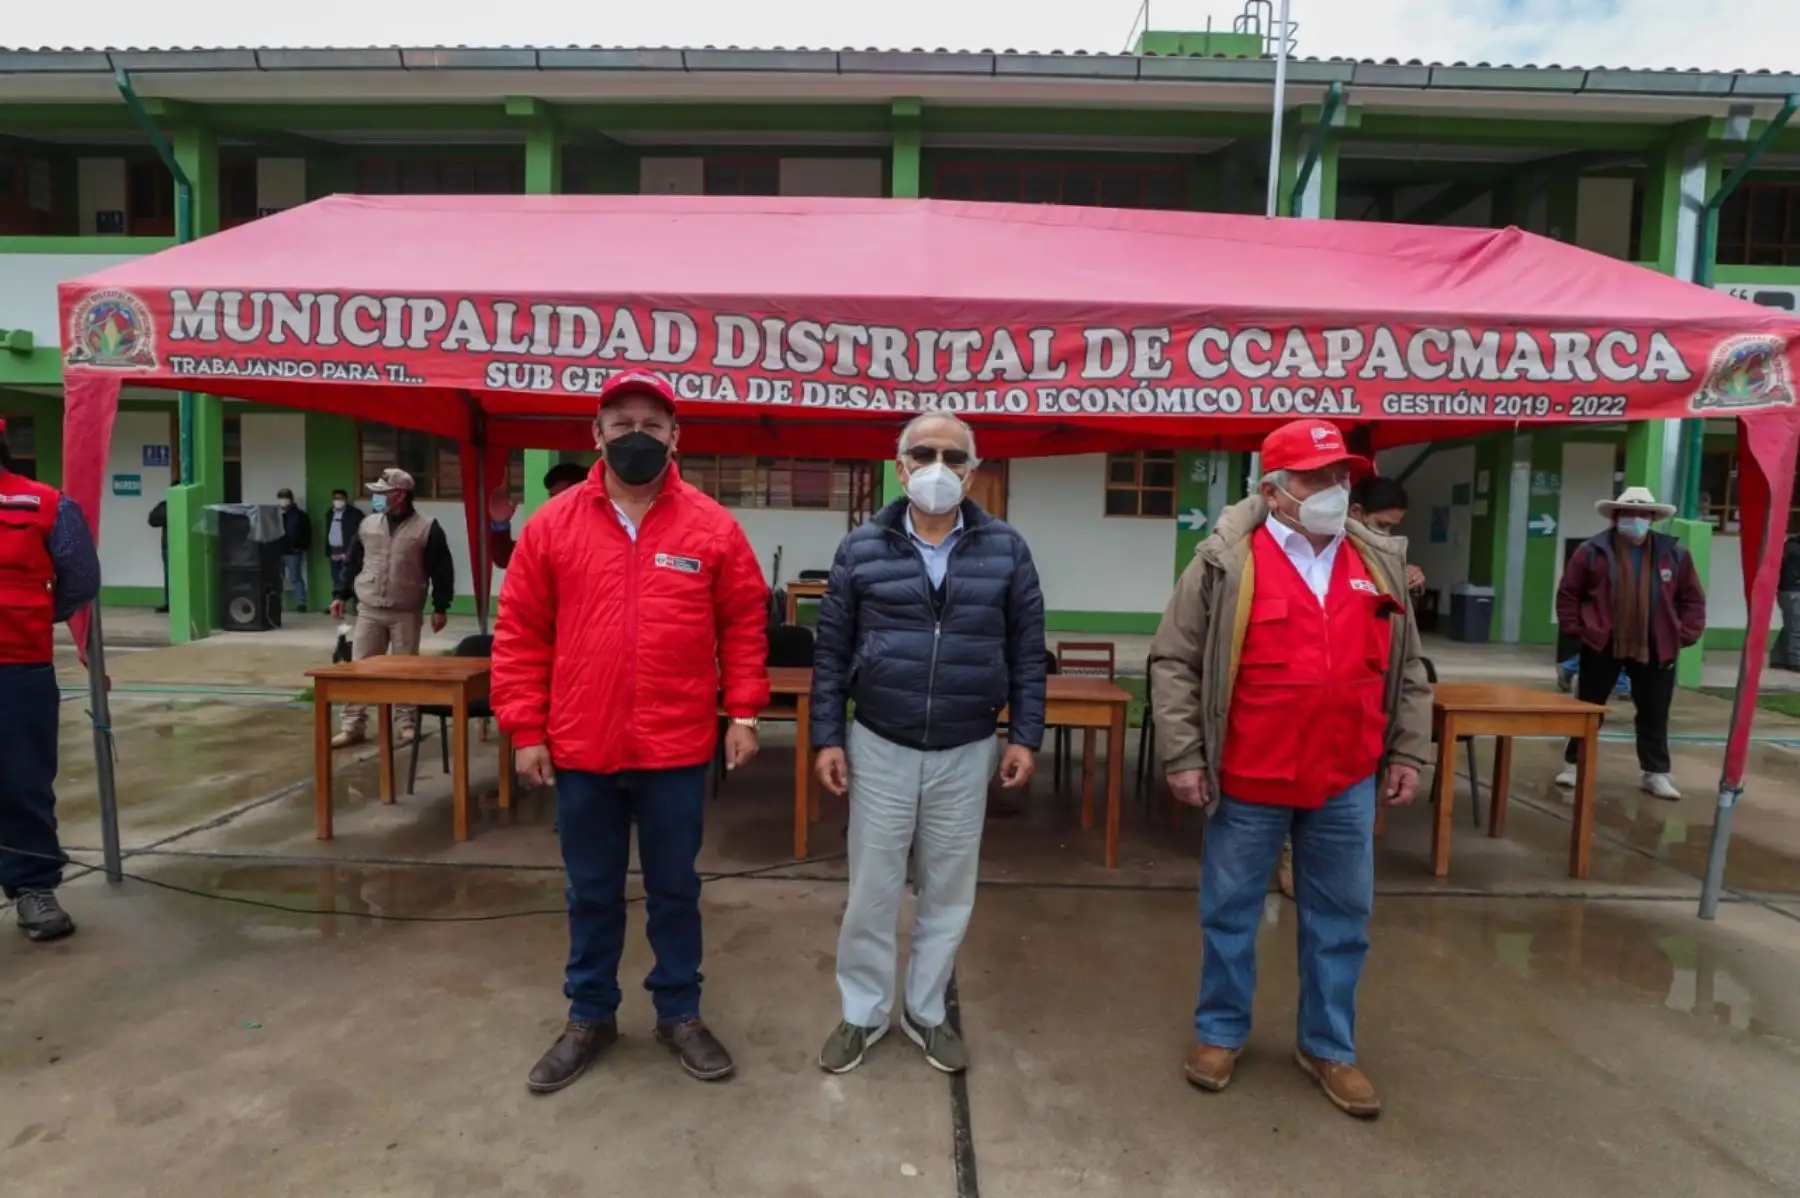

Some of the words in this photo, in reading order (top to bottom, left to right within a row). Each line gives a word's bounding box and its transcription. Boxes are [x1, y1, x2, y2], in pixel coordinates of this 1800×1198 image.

[168, 288, 698, 364] MUNICIPALIDAD
[711, 314, 1068, 382] DISTRITAL
[1080, 327, 1173, 380] DE
[1187, 326, 1692, 382] CCAPACMARCA
[168, 356, 317, 378] TRABAJANDO
[322, 361, 379, 381] PARA
[385, 364, 424, 384] TI...
[485, 361, 554, 390] SUB
[745, 376, 793, 405] DE
[801, 381, 1029, 413] DESARROLLO
[1035, 380, 1243, 414] ECONÓMICO
[1249, 386, 1361, 414] LOCAL
[1382, 391, 1487, 414] GESTIÓN
[1493, 395, 1549, 416] 2019
[1554, 404, 1565, 412] -
[1568, 396, 1627, 416] 2022
